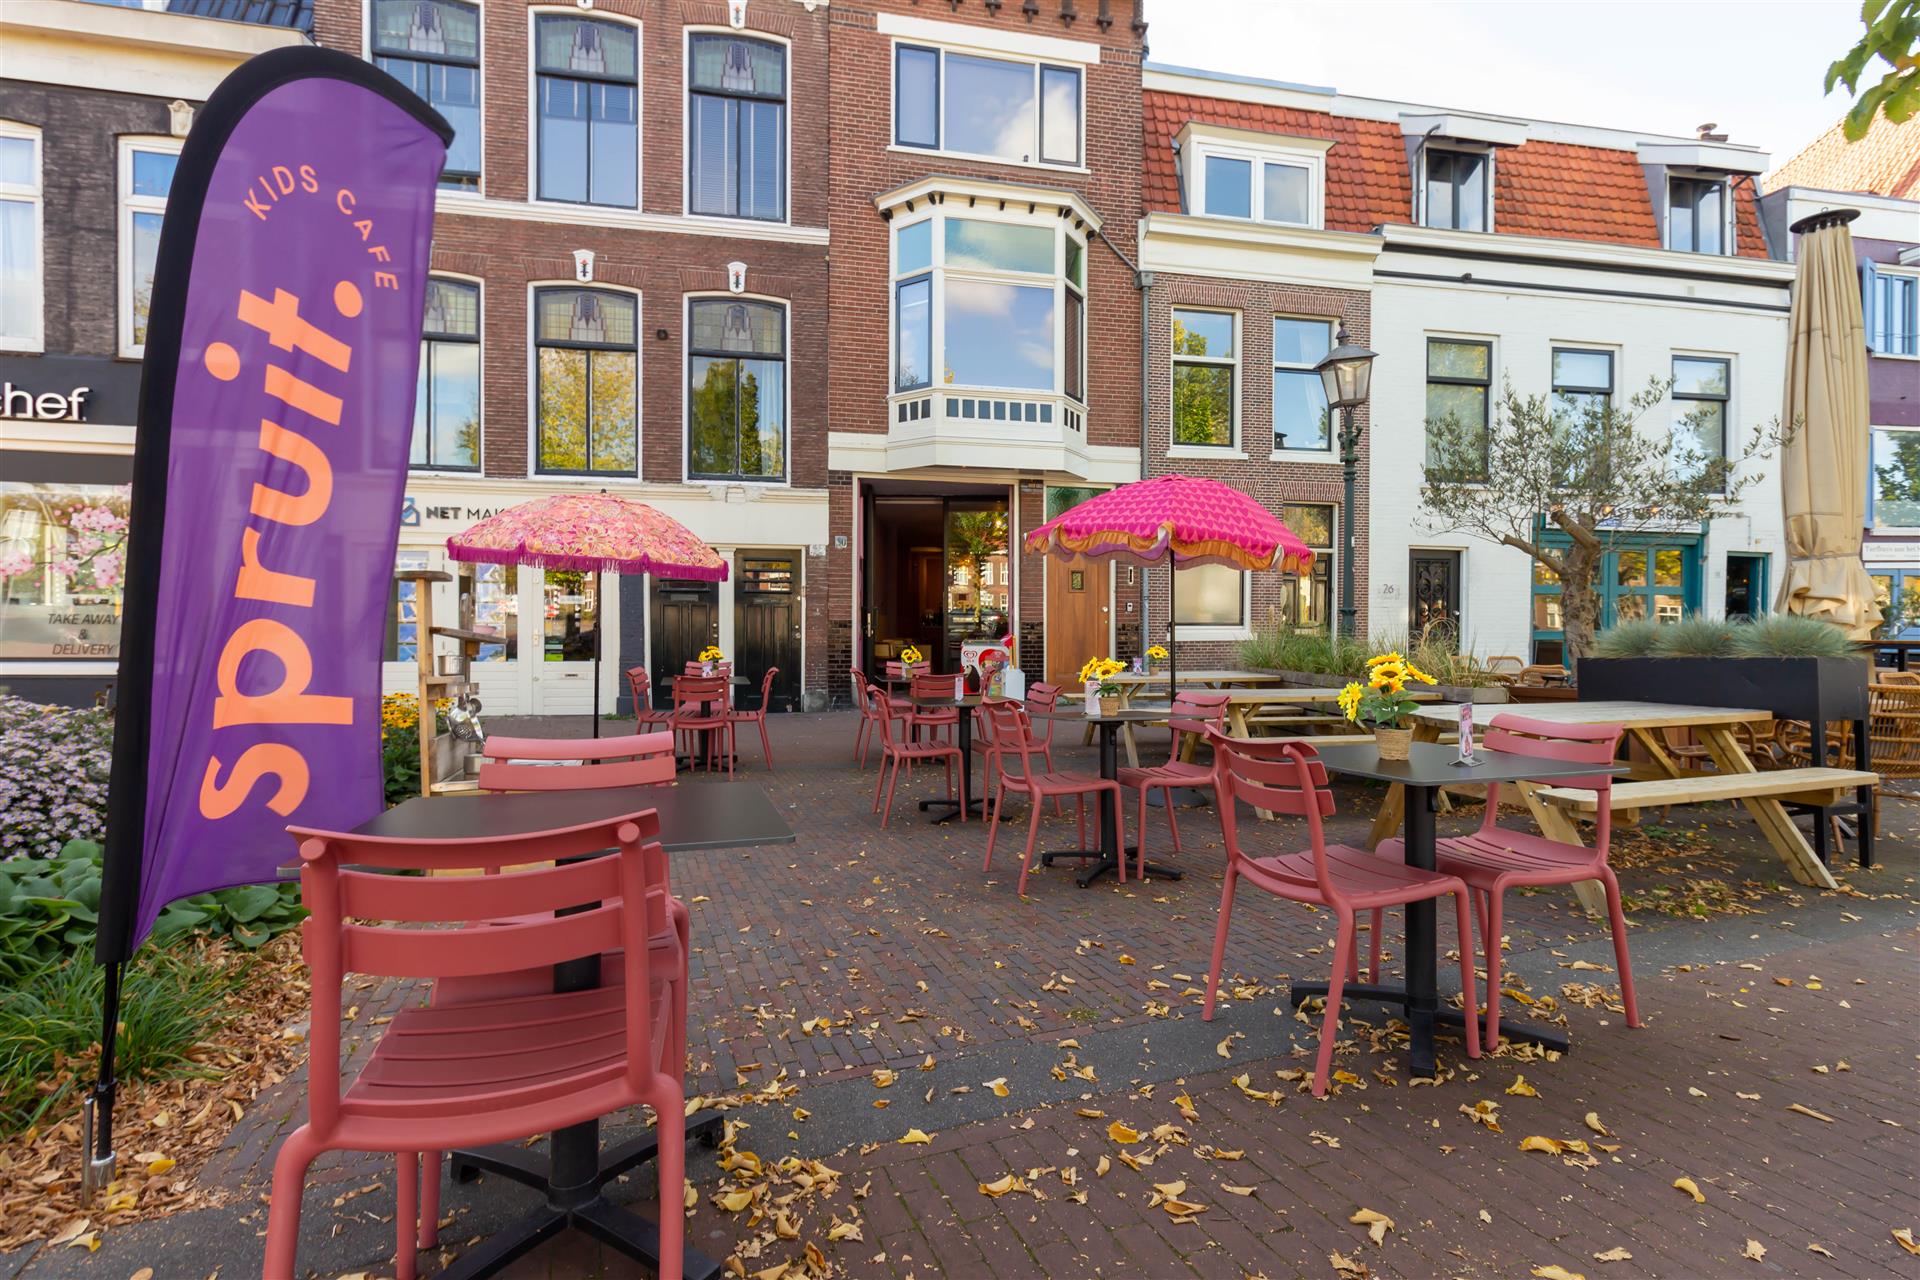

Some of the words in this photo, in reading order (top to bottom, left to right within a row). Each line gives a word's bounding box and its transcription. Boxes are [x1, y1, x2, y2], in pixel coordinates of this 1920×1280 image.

[243, 164, 319, 221] KIDS
[336, 188, 398, 290] CAFE
[0, 381, 89, 421] hef
[426, 506, 462, 520] NET
[1383, 583, 1394, 594] 26
[48, 613, 80, 624] TAKE
[81, 613, 120, 624] AWAY
[79, 628, 88, 640] &
[52, 643, 114, 655] DELIVERY
